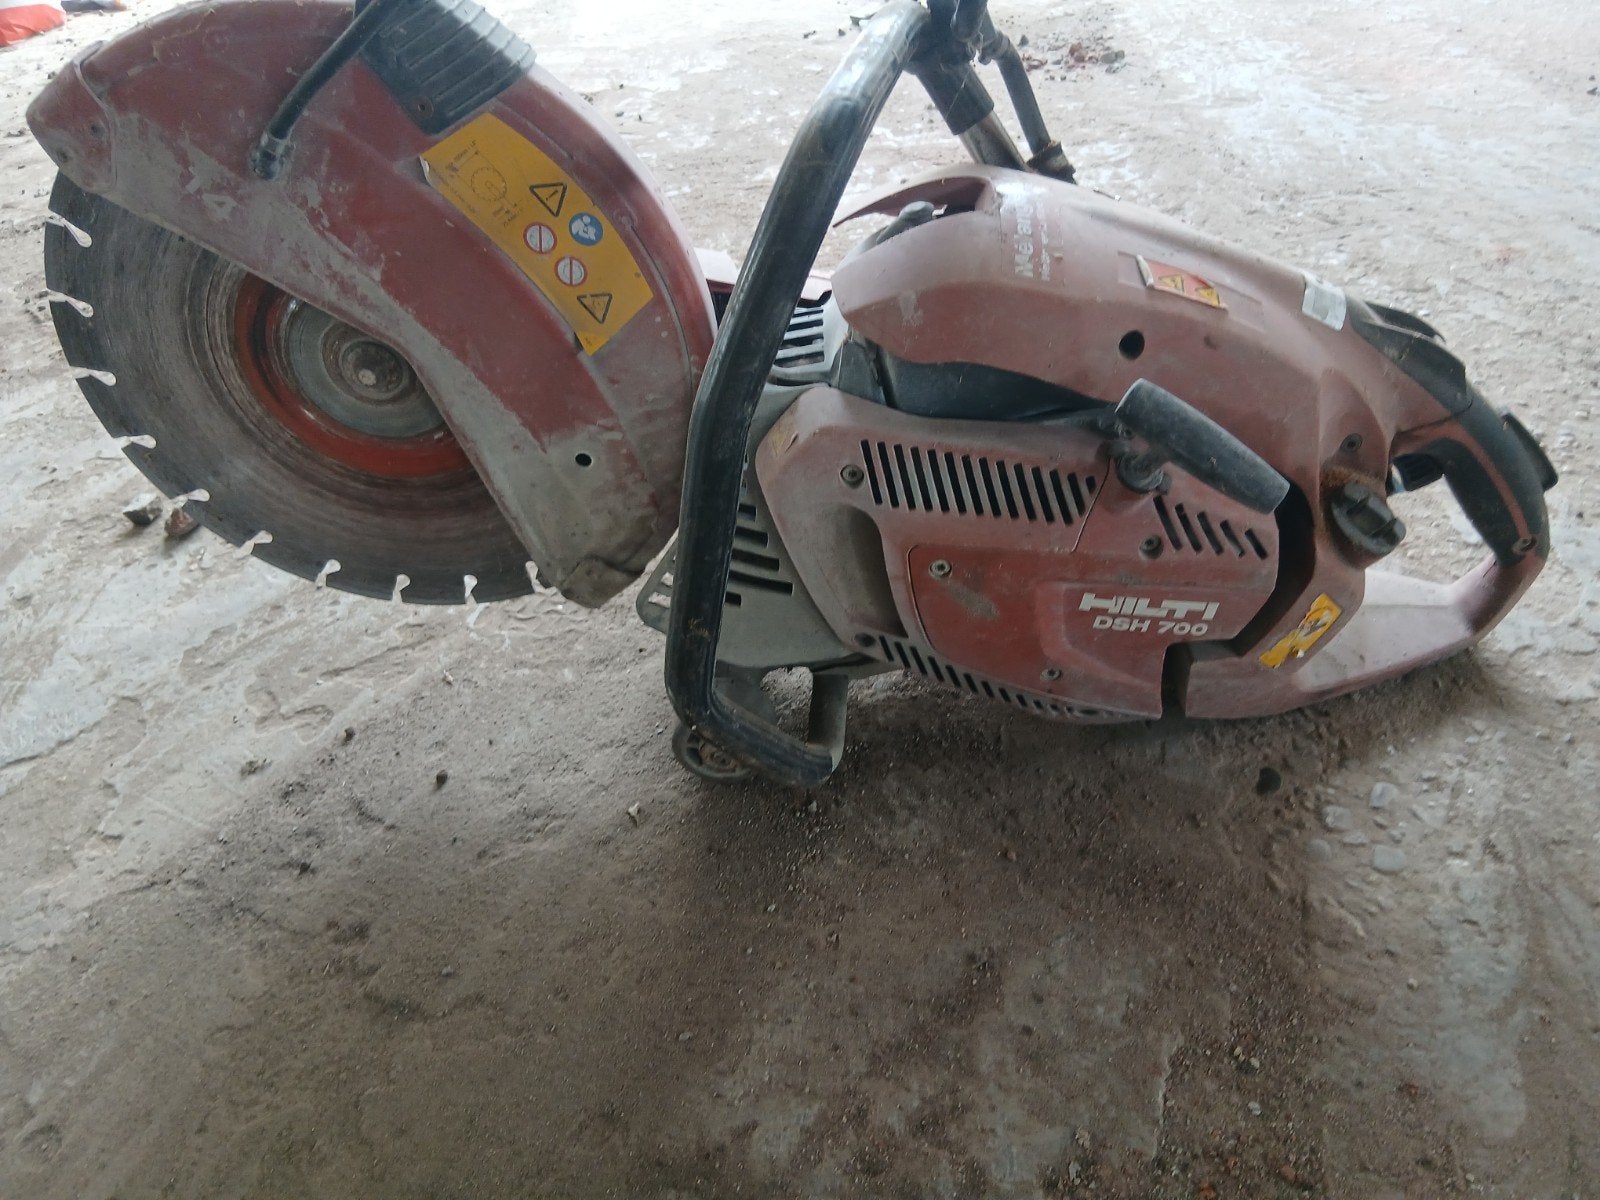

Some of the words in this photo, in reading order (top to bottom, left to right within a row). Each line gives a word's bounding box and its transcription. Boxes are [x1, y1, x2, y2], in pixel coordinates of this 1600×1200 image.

[1079, 592, 1220, 620] HILTI
[1093, 615, 1151, 632] DSH
[1157, 620, 1208, 636] 700
